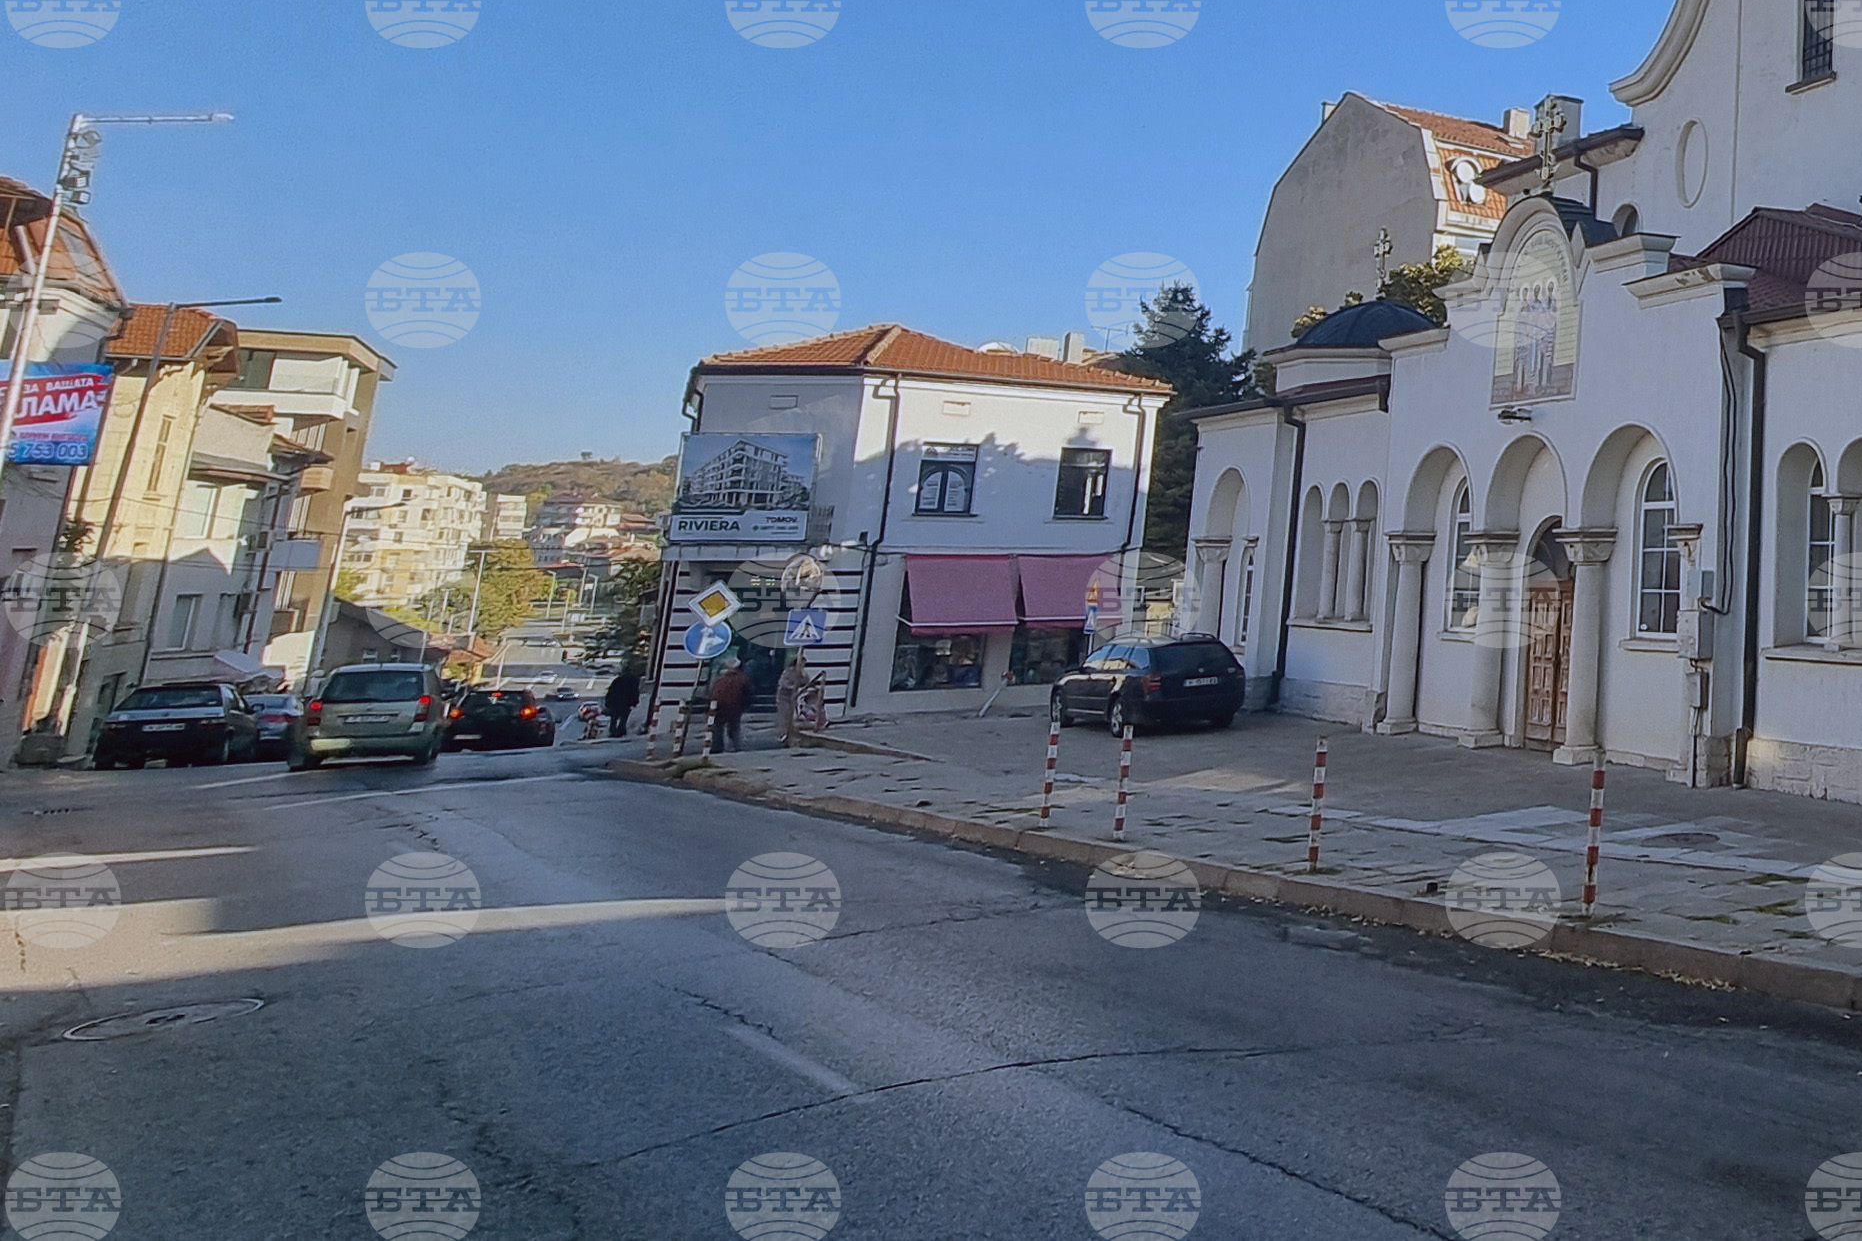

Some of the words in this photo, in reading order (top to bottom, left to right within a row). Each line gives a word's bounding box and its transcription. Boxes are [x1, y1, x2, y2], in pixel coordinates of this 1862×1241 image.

[15, 390, 99, 418] ЛАМА
[58, 444, 88, 457] 003
[678, 520, 740, 532] RIVIERA
